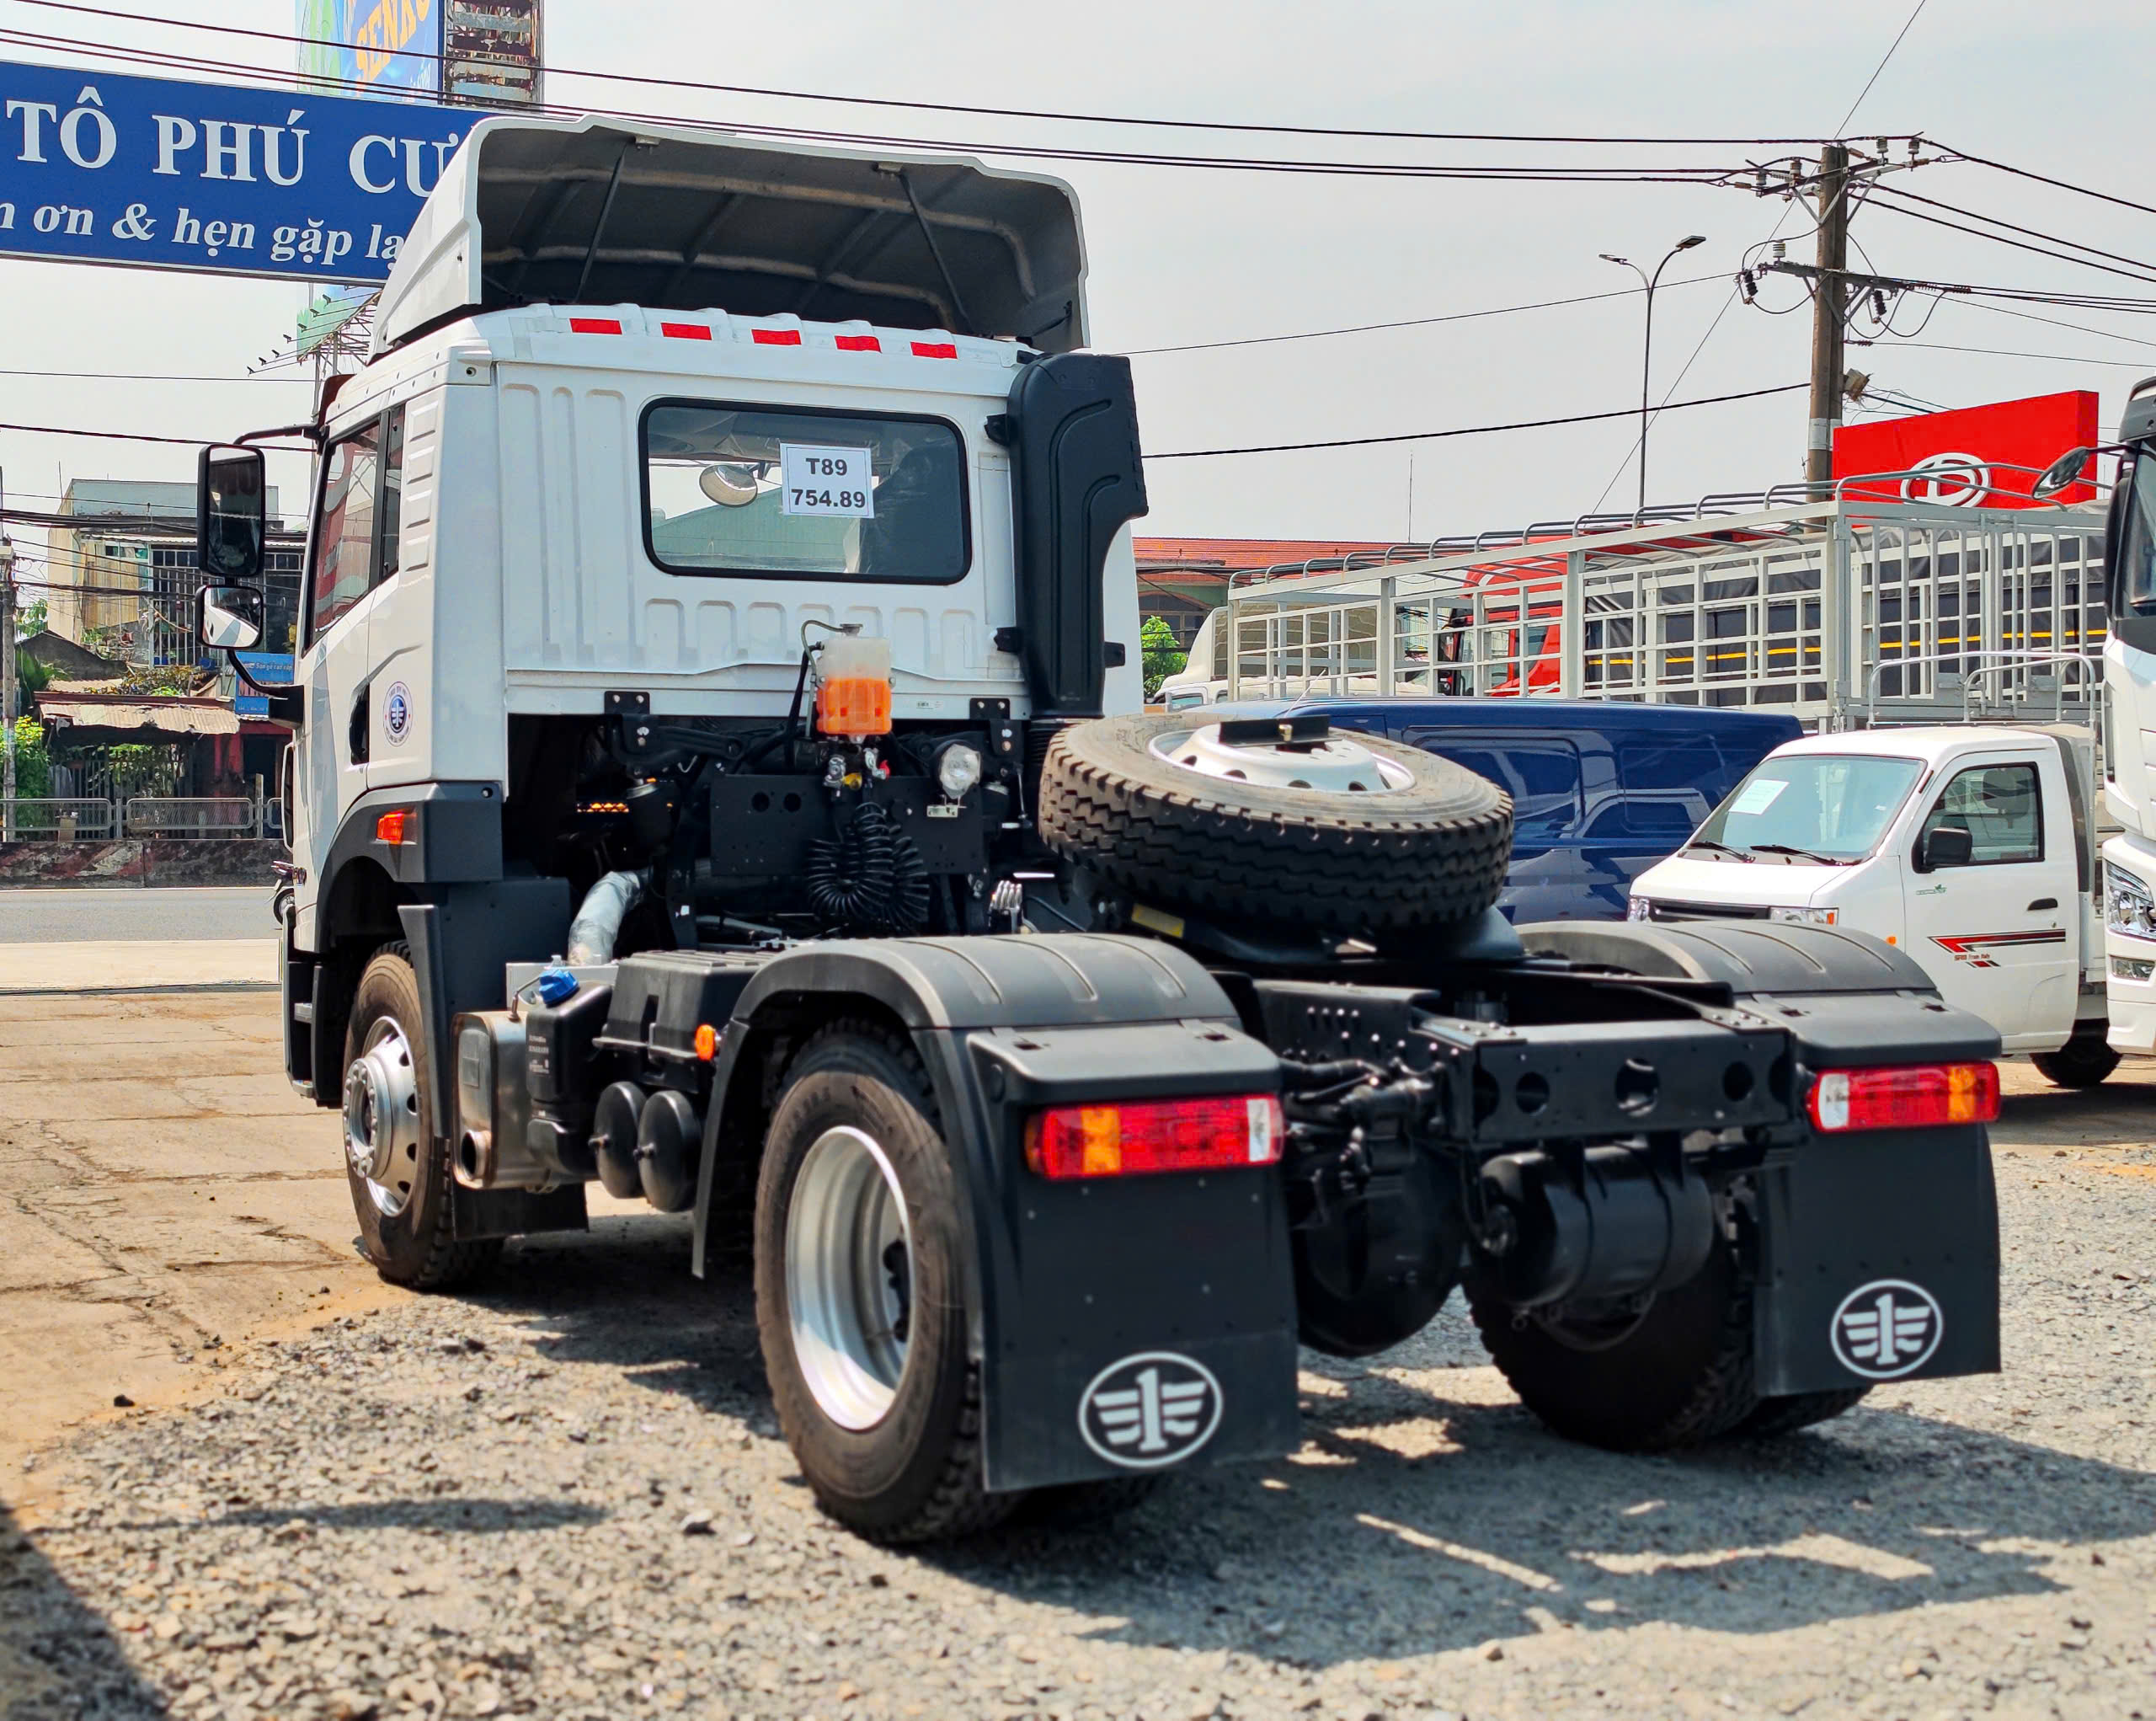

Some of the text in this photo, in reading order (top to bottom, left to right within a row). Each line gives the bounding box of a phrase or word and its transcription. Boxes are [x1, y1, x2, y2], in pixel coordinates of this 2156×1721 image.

[356, 0, 430, 97] SENK
[7, 86, 460, 198] TÔ PHÚ CƯ
[34, 205, 93, 235] ơn
[112, 204, 157, 241] &
[171, 207, 255, 257] hẹn
[270, 217, 353, 265] gặp
[805, 457, 848, 476] T89
[791, 489, 866, 508] 754.89
